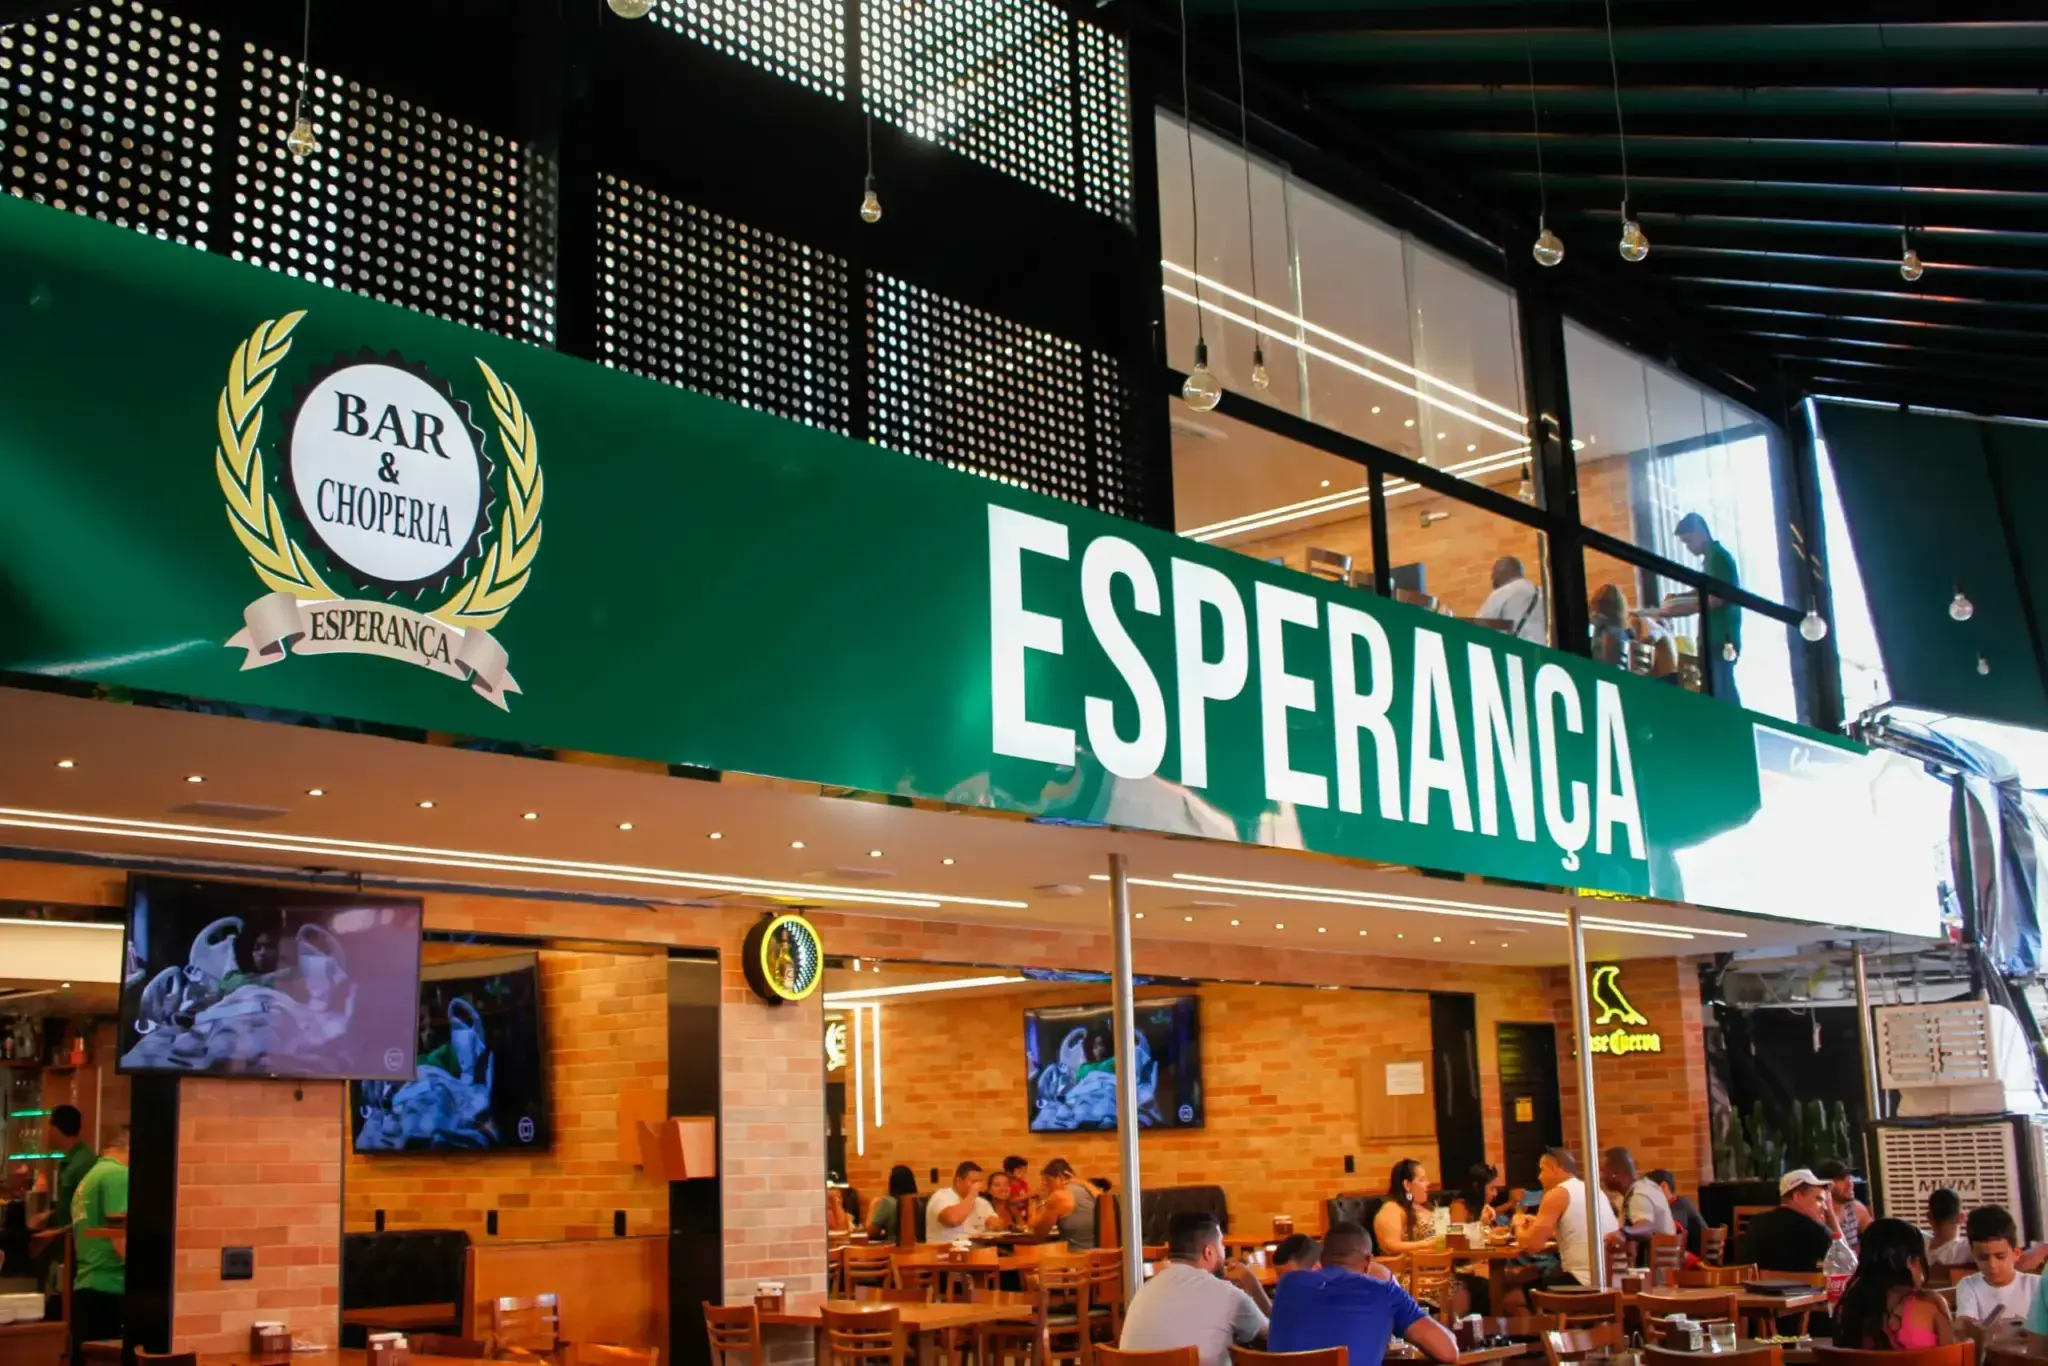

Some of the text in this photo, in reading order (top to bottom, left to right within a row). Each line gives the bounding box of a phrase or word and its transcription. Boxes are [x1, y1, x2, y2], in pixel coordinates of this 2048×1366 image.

[333, 391, 451, 459] BAR
[378, 451, 400, 484] &
[317, 478, 452, 547] CHOPERIA
[310, 609, 452, 665] ESPERANÇA
[988, 503, 1648, 871] ESPERANÇA
[1919, 1179, 1976, 1192] MWM
